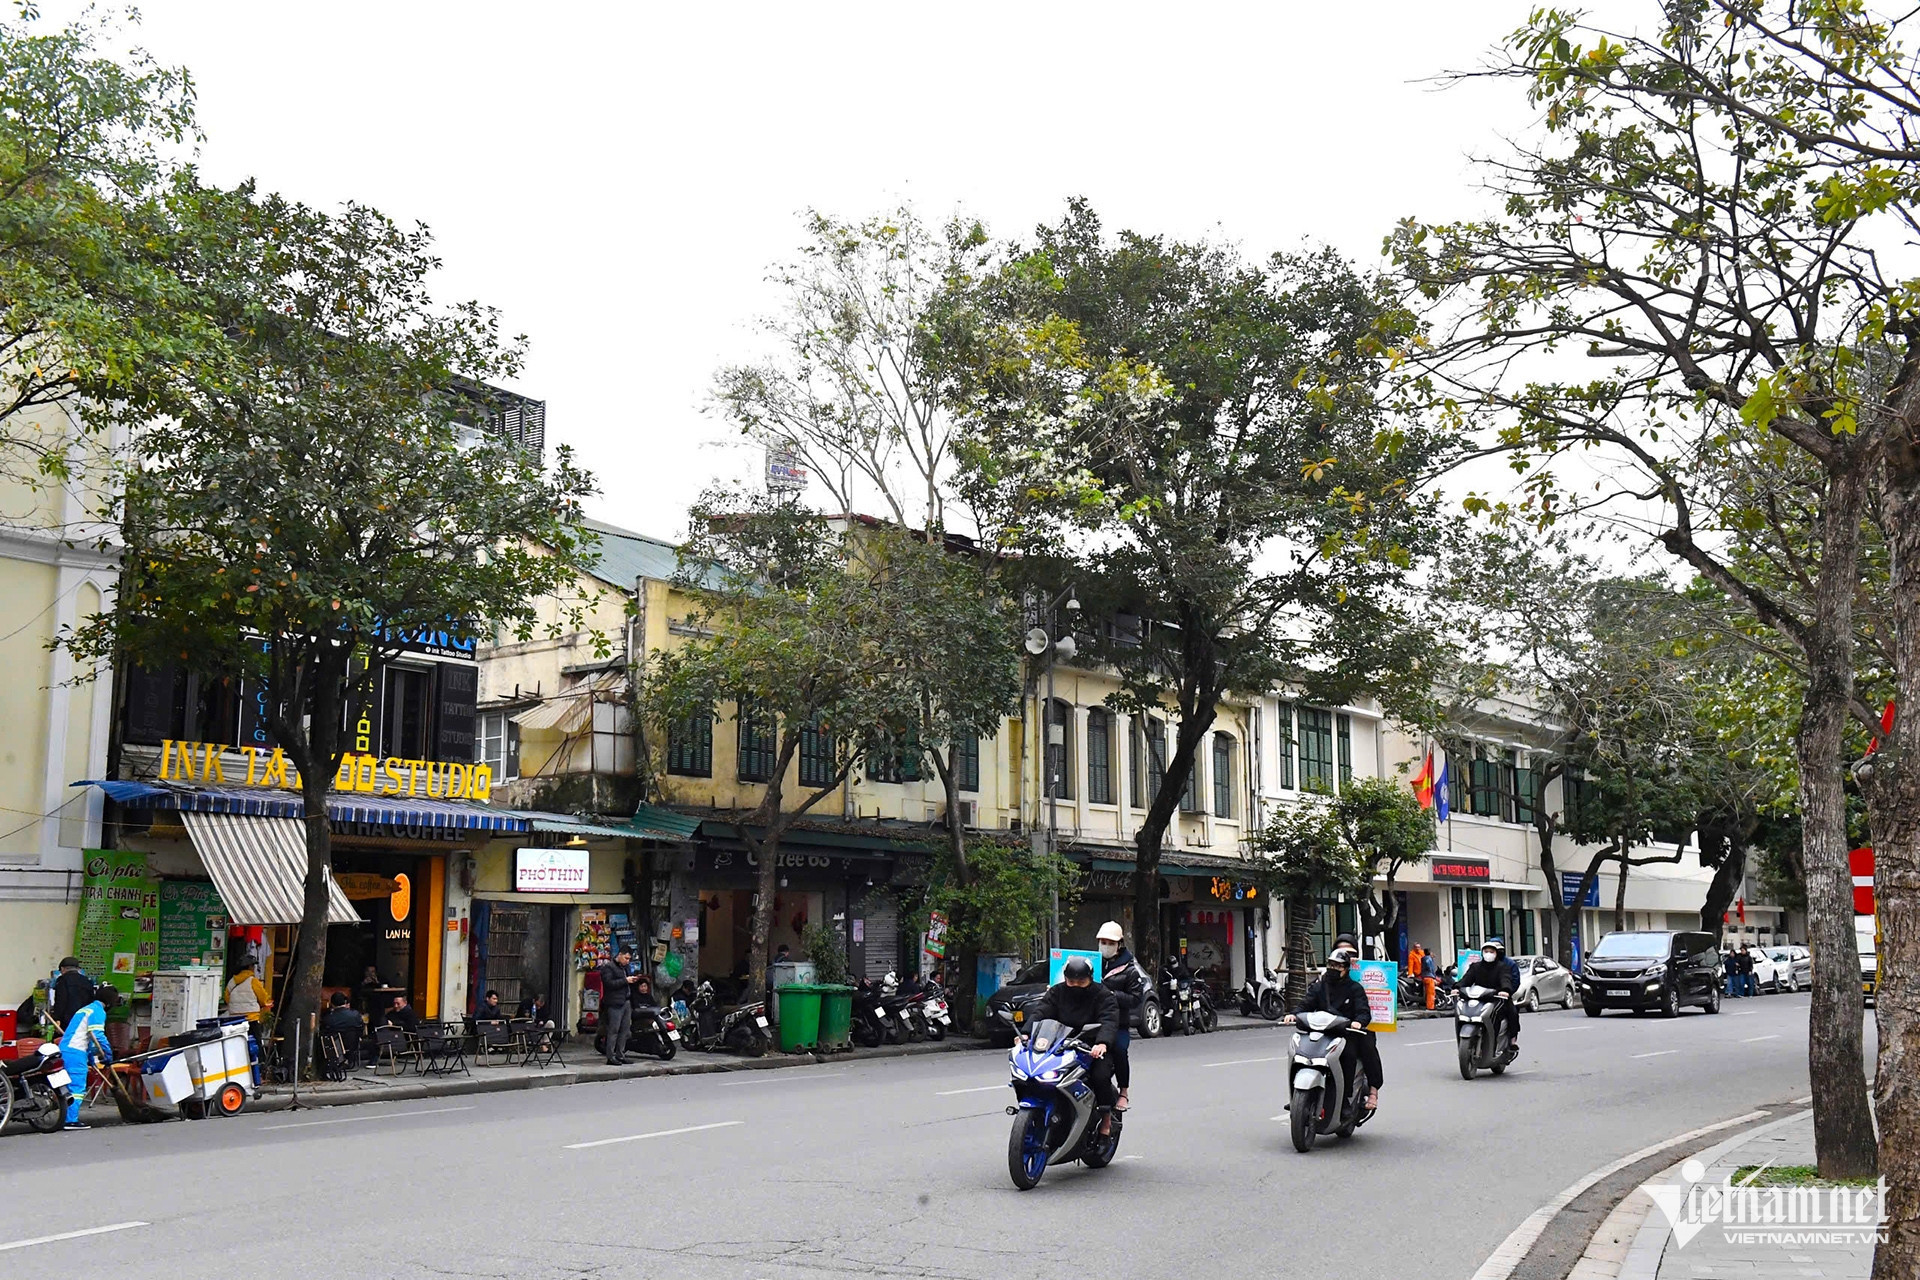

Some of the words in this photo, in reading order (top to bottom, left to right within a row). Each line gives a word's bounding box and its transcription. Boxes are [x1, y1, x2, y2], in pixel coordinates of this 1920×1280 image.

[158, 739, 229, 783] INK
[381, 757, 493, 799] STUDIO
[392, 824, 466, 841] COFFEE
